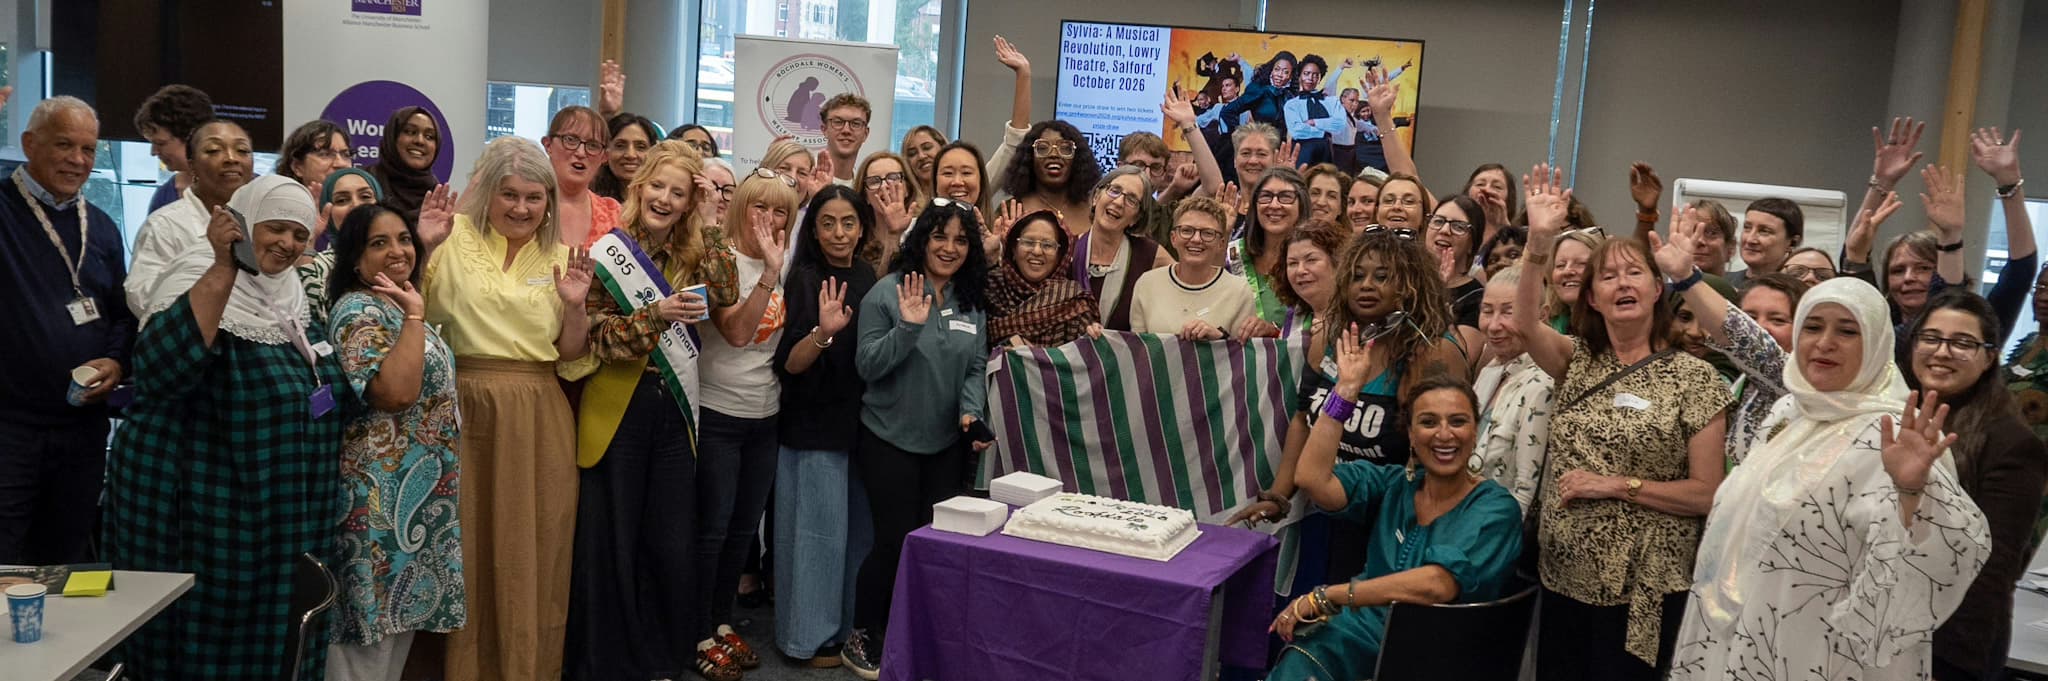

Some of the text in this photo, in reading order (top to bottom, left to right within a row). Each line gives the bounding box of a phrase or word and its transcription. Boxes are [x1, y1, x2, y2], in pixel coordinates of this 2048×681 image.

[1067, 23, 1160, 42] Sylvia: A Musical
[1063, 40, 1161, 61] Revolution, Lowry
[776, 60, 850, 82] ROCHDALE WOMEN'S
[1064, 57, 1156, 77] Theatre, Salford,
[1072, 74, 1145, 92] October 2026
[606, 245, 636, 276] 695
[672, 322, 697, 360] tenary
